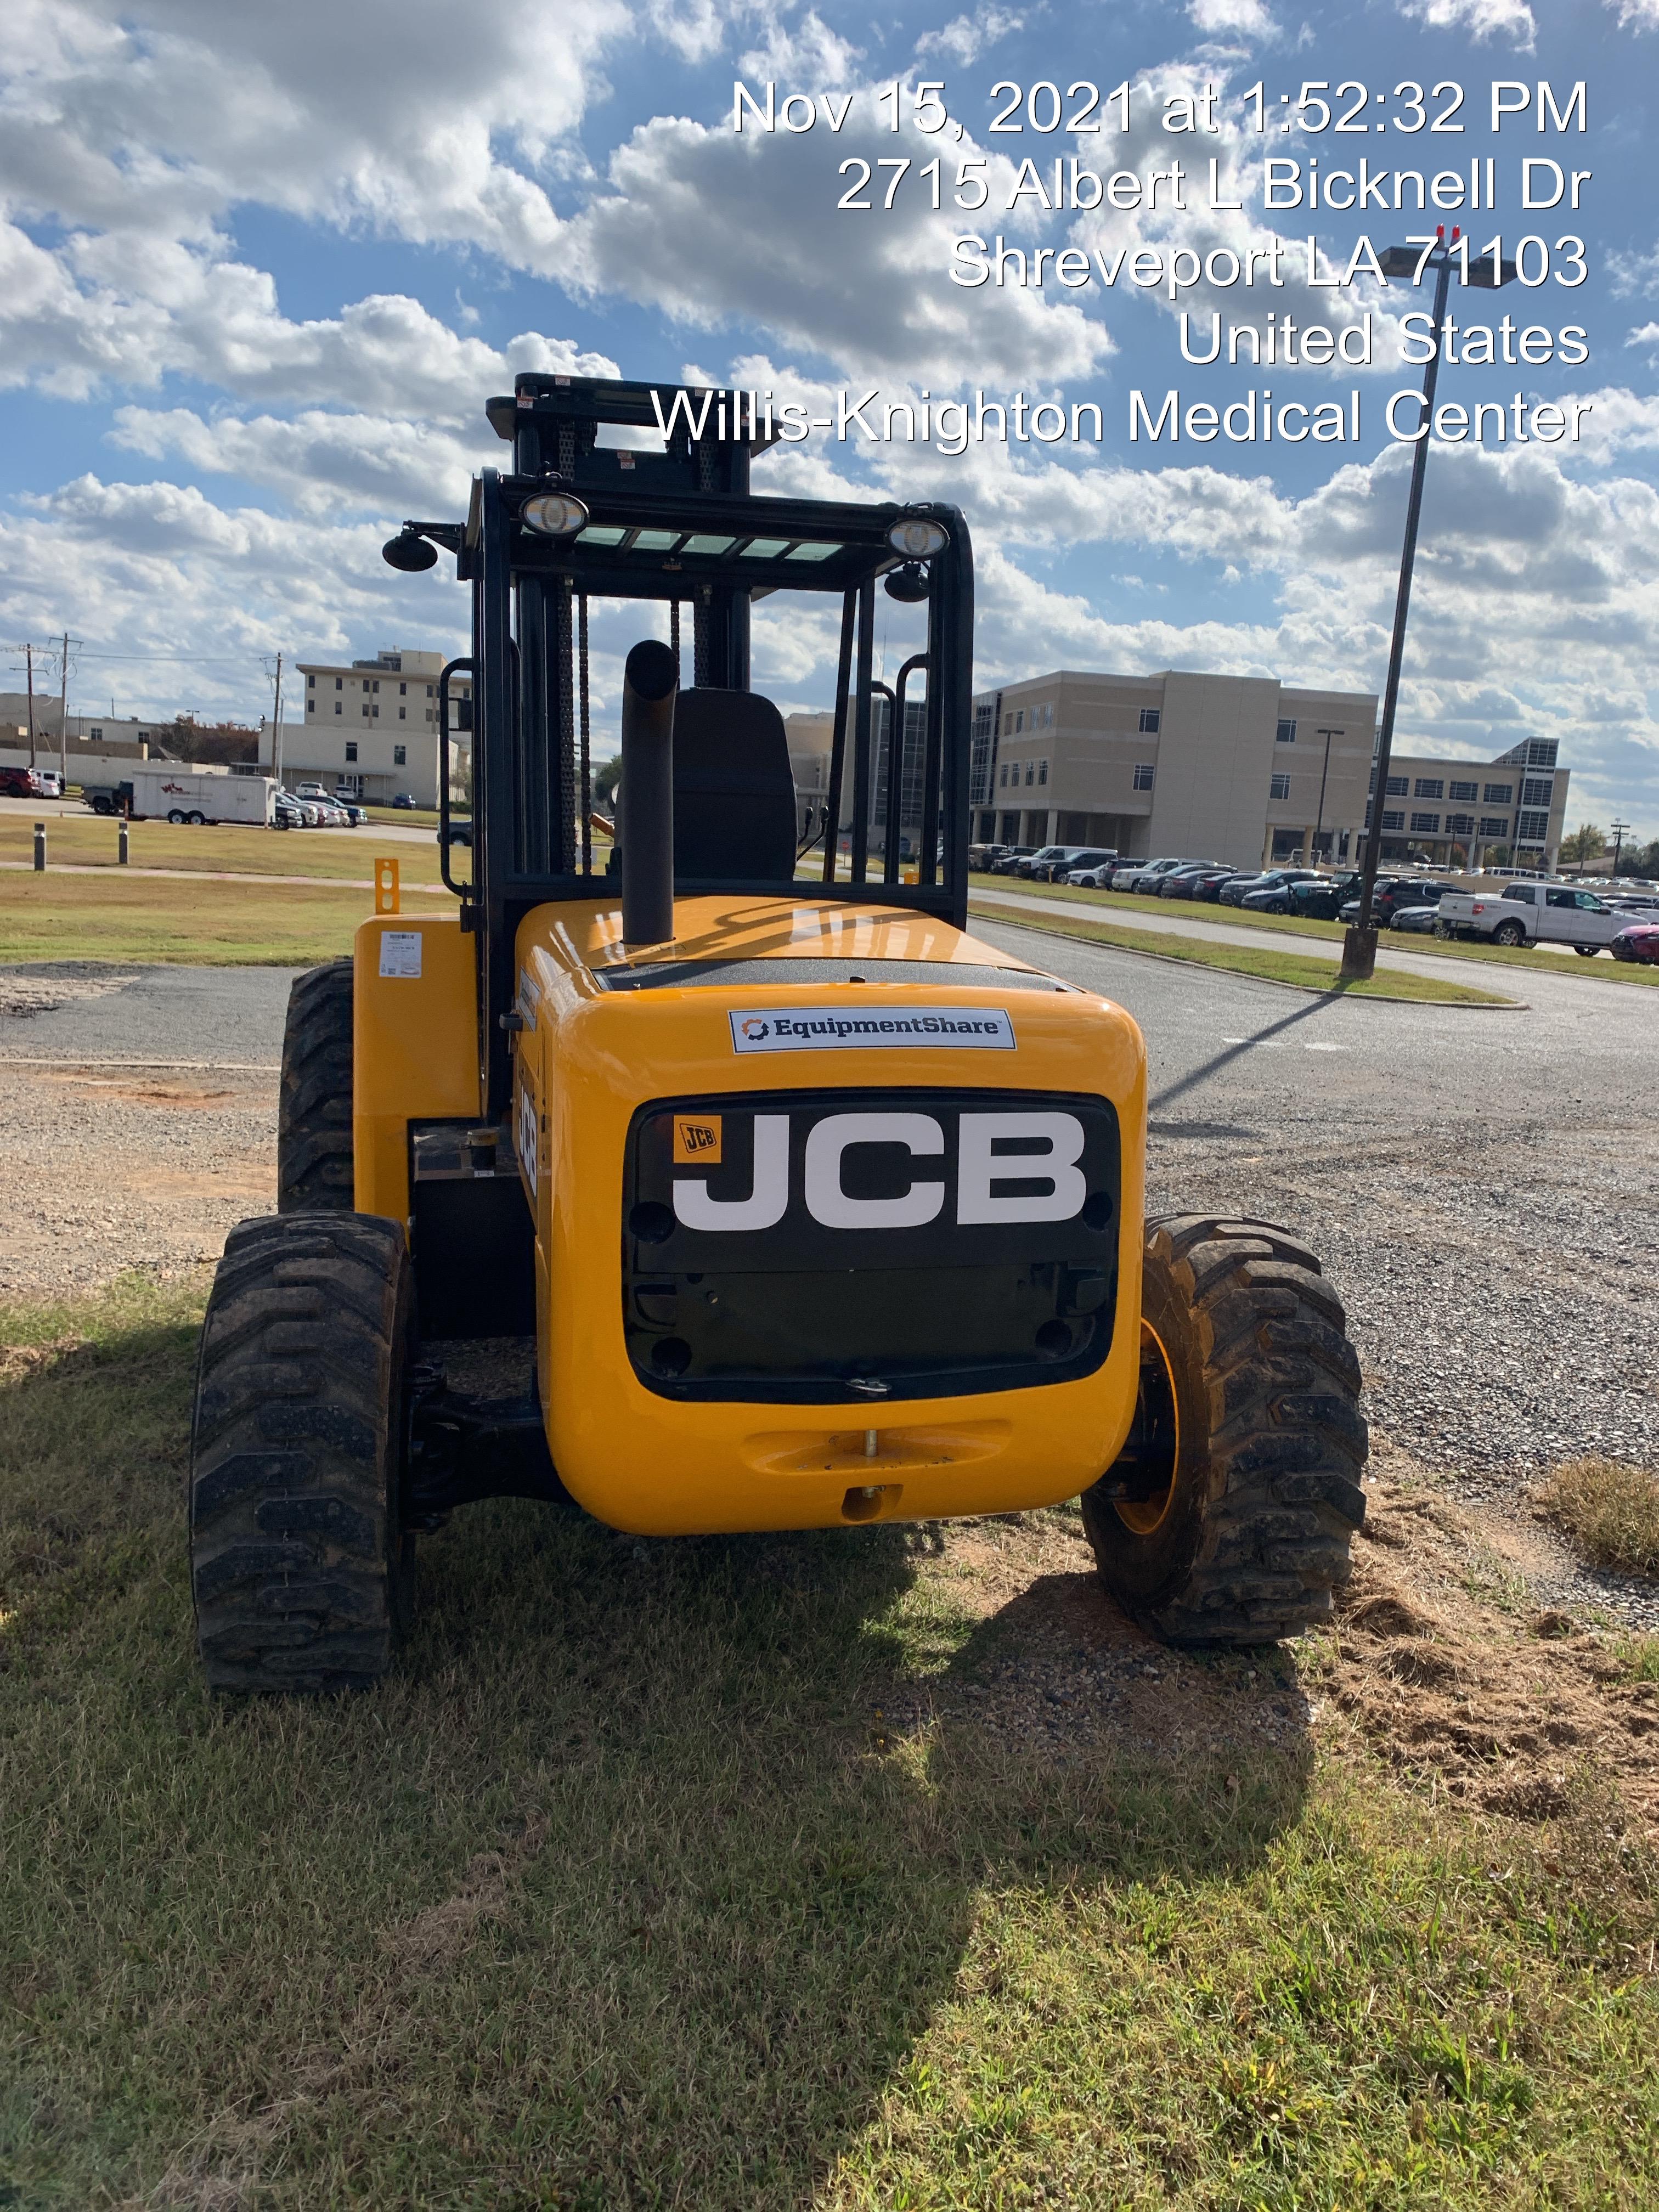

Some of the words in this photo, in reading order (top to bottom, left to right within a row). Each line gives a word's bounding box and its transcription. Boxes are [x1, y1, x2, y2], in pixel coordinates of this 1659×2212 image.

[519, 1082, 537, 1198] JCB
[673, 1112, 1086, 1231] JCB
[686, 1126, 714, 1150] JCB
